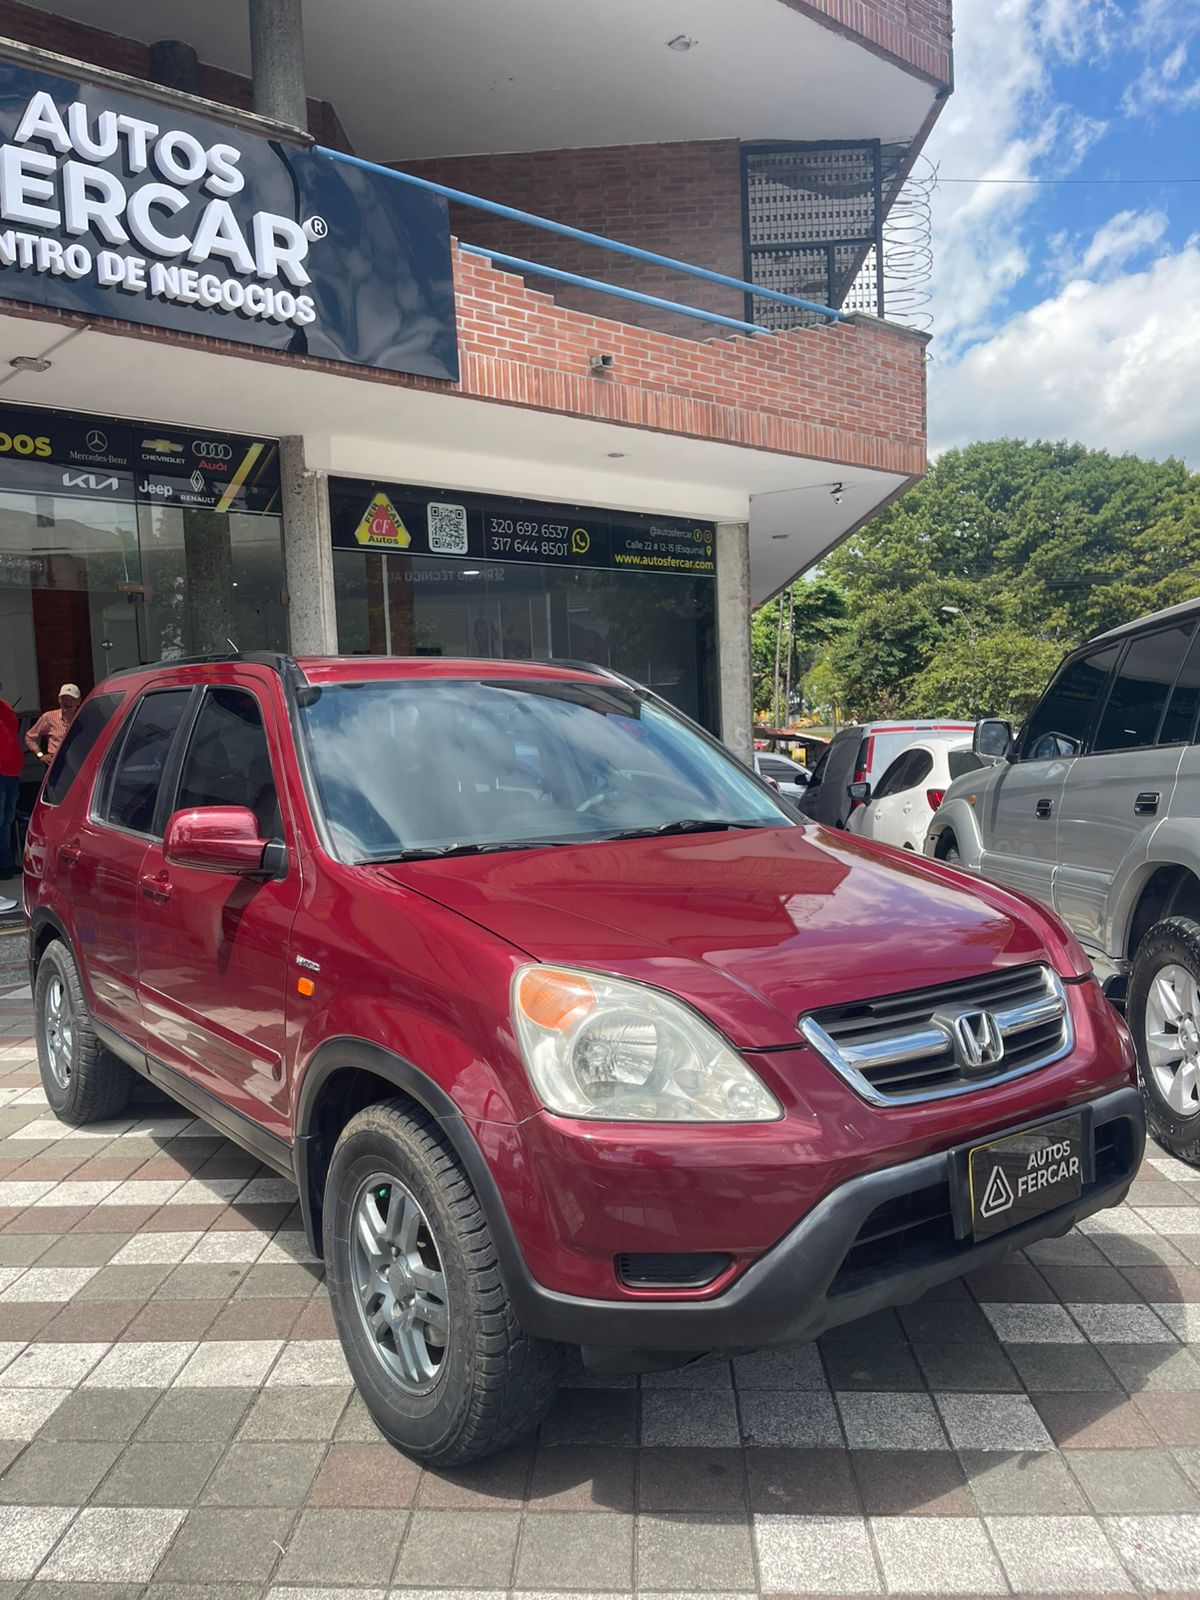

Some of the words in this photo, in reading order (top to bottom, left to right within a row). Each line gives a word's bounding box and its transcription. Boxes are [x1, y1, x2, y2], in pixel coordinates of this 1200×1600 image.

[14, 90, 245, 197] AUTOS
[97, 250, 147, 292] DE
[150, 262, 316, 326] NEGOCIOS
[70, 450, 128, 465] Mercedes-Benz
[141, 453, 186, 465] CHEVROLET
[198, 459, 228, 472] Audi
[62, 472, 119, 491] KIA
[138, 479, 173, 497] Jeep
[180, 493, 216, 504] RENAULT
[364, 502, 380, 525] FER
[384, 503, 402, 529] CAR
[371, 518, 392, 534] CF
[490, 518, 513, 533] 320
[516, 521, 539, 536] 692
[541, 524, 569, 539] 6537
[367, 535, 399, 545] Autos
[491, 537, 511, 551] 317
[514, 539, 538, 553] 644
[541, 541, 569, 556] 8501
[625, 539, 643, 550] Calle
[644, 541, 653, 551] 22
[614, 553, 714, 570] www.autosfercar.com
[1027, 1140, 1070, 1171] AUTOS
[1018, 1156, 1079, 1197] FERCAR
